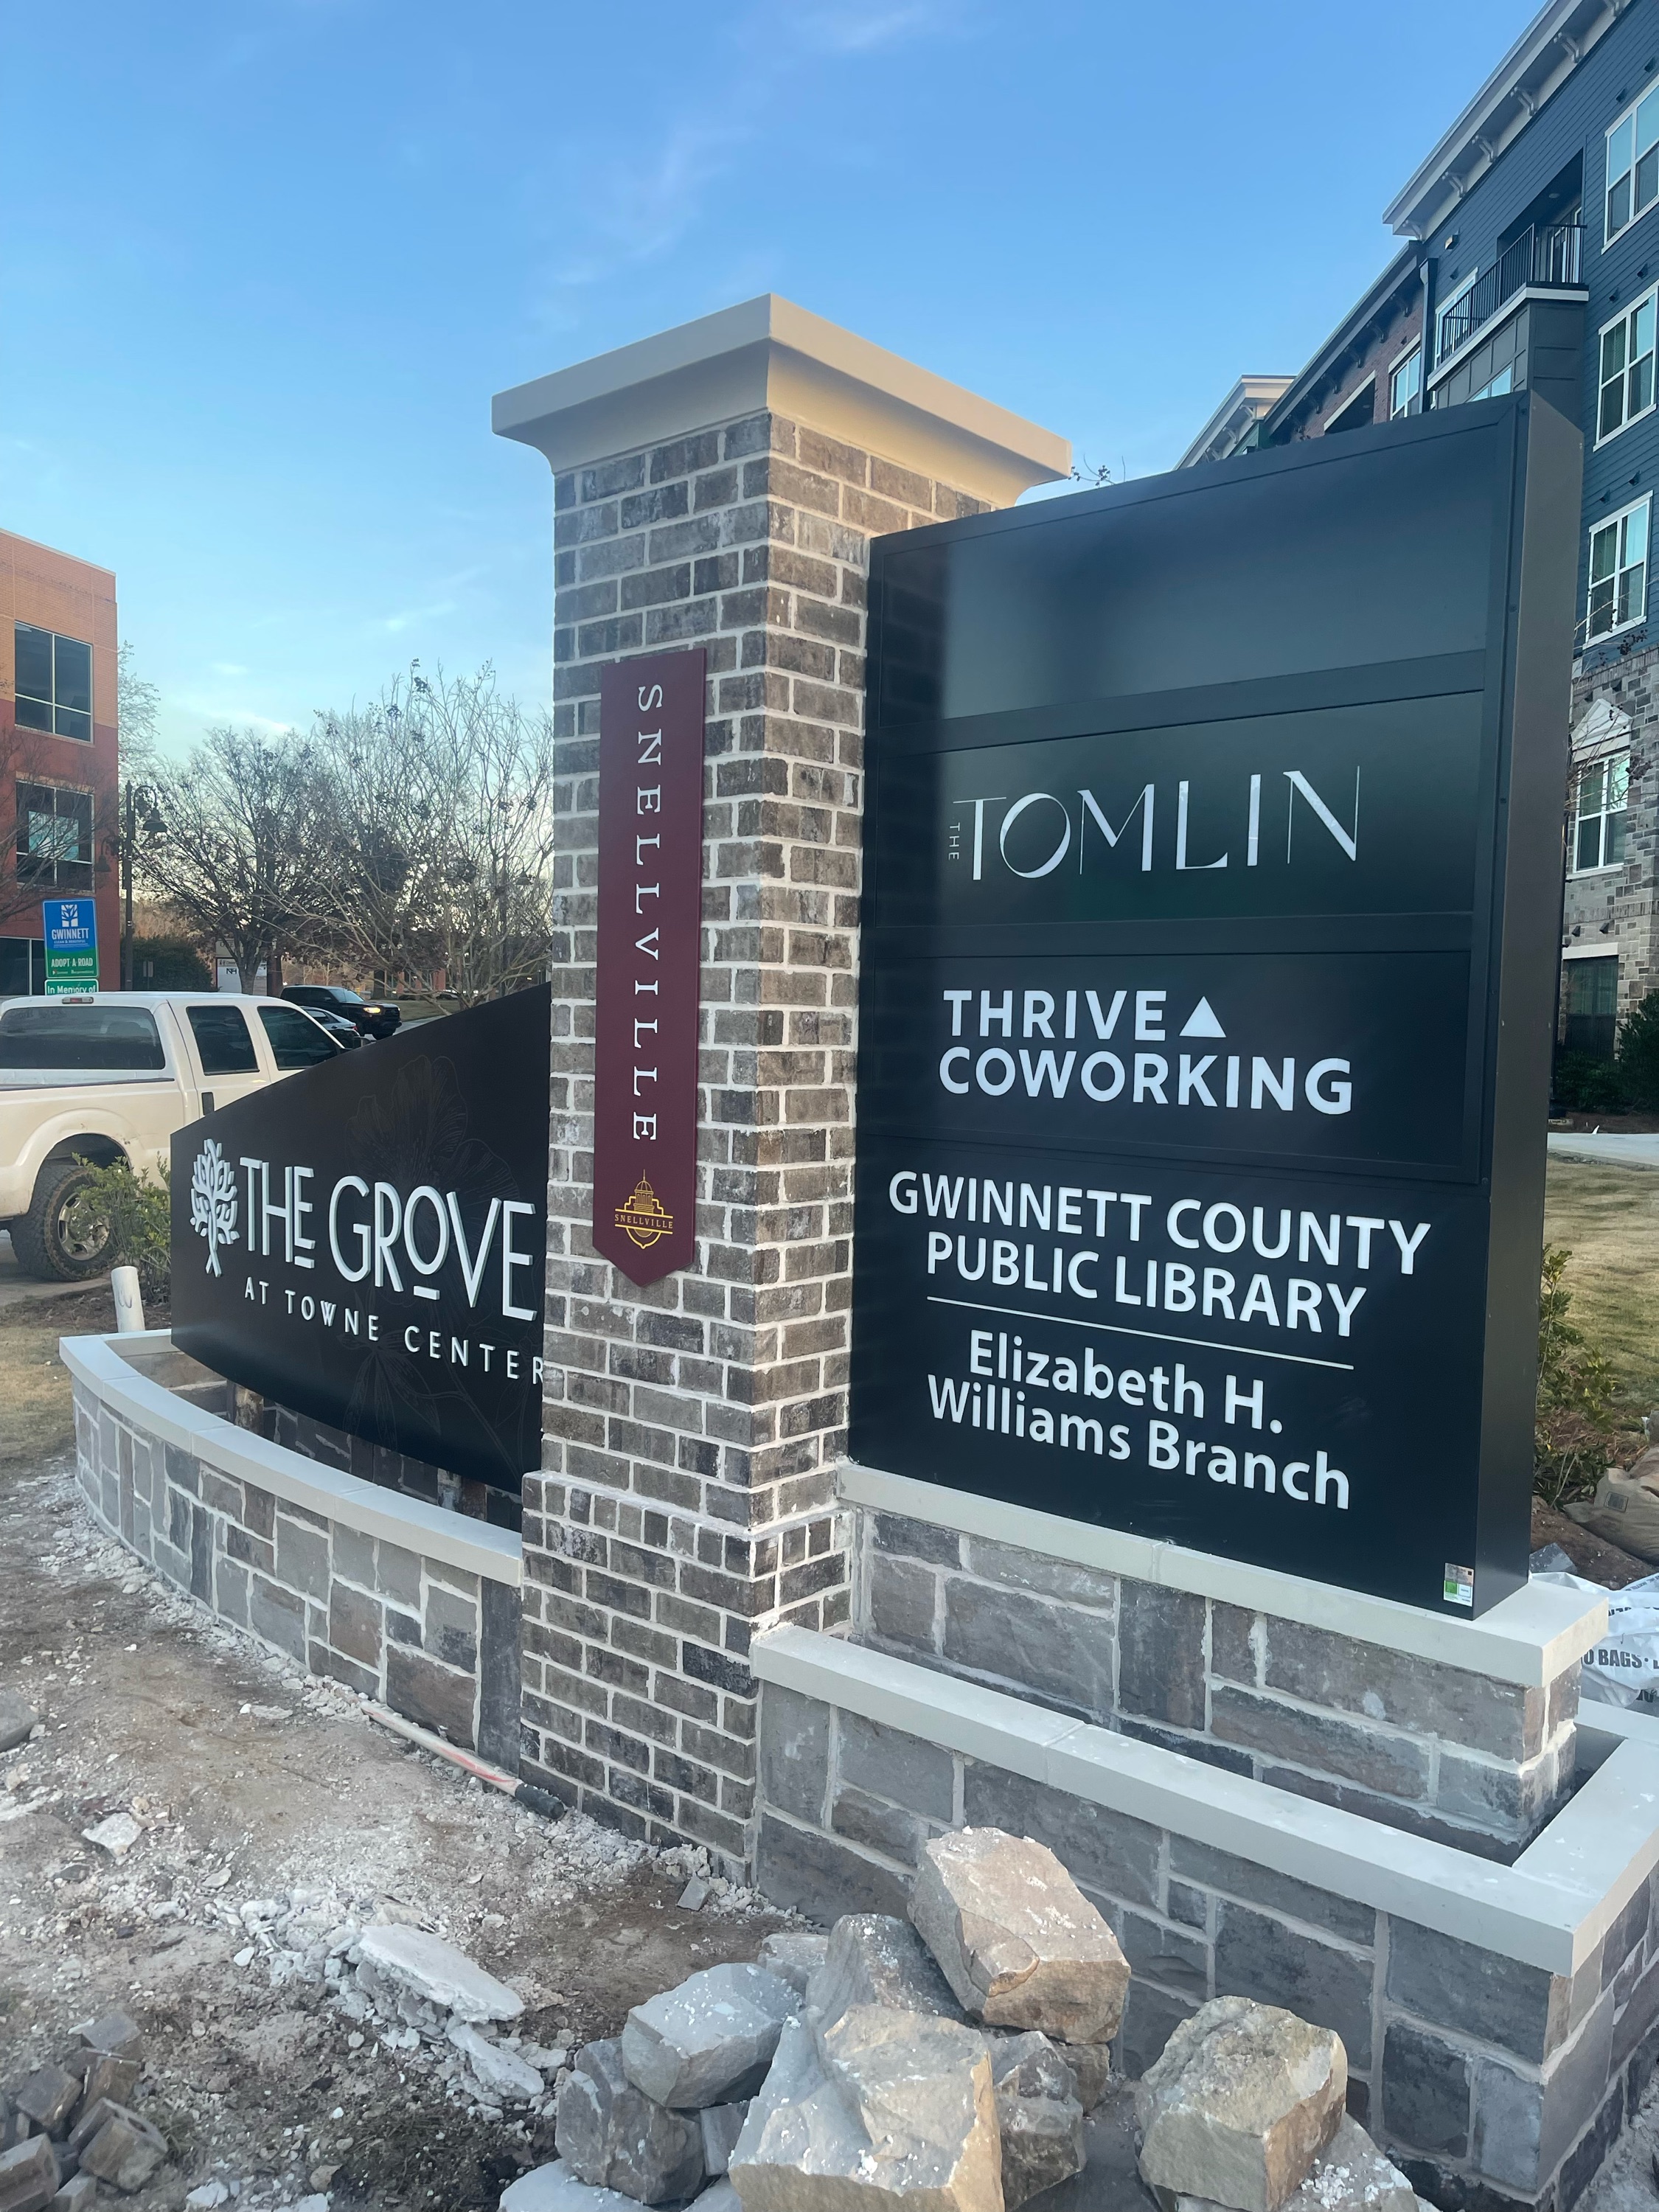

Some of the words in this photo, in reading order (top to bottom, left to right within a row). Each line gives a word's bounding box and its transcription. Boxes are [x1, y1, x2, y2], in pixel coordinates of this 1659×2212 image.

[948, 822, 961, 860] THE
[953, 765, 1360, 880] TOMLIN
[52, 928, 89, 940] GWINNETT
[632, 684, 663, 1141] SNELLVILLE
[47, 985, 55, 994] In
[57, 985, 87, 994] Memory
[88, 984, 96, 992] of
[51, 959, 70, 967] ADOPT
[78, 958, 93, 967] ROAD
[942, 990, 1167, 1041] THRIVE
[939, 1046, 1353, 1116] COWORKING
[239, 1157, 316, 1269] THE
[329, 1175, 537, 1322] GROVE
[614, 1214, 673, 1229] SNELLVILLE
[888, 1171, 1152, 1242] GWINNETT
[1166, 1199, 1431, 1275] COUNTY
[927, 1231, 1099, 1298] PUBLIC
[1115, 1256, 1367, 1338] LIBRARY
[244, 1276, 269, 1305] AT
[285, 1290, 380, 1342] TOWNE
[404, 1326, 543, 1385] CENTER
[970, 1329, 1204, 1419] Elizabeth
[1225, 1374, 1283, 1434] H.
[928, 1374, 1131, 1461] Williams
[1148, 1419, 1350, 1510] Branch
[1598, 1649, 1643, 1669] BAGS
